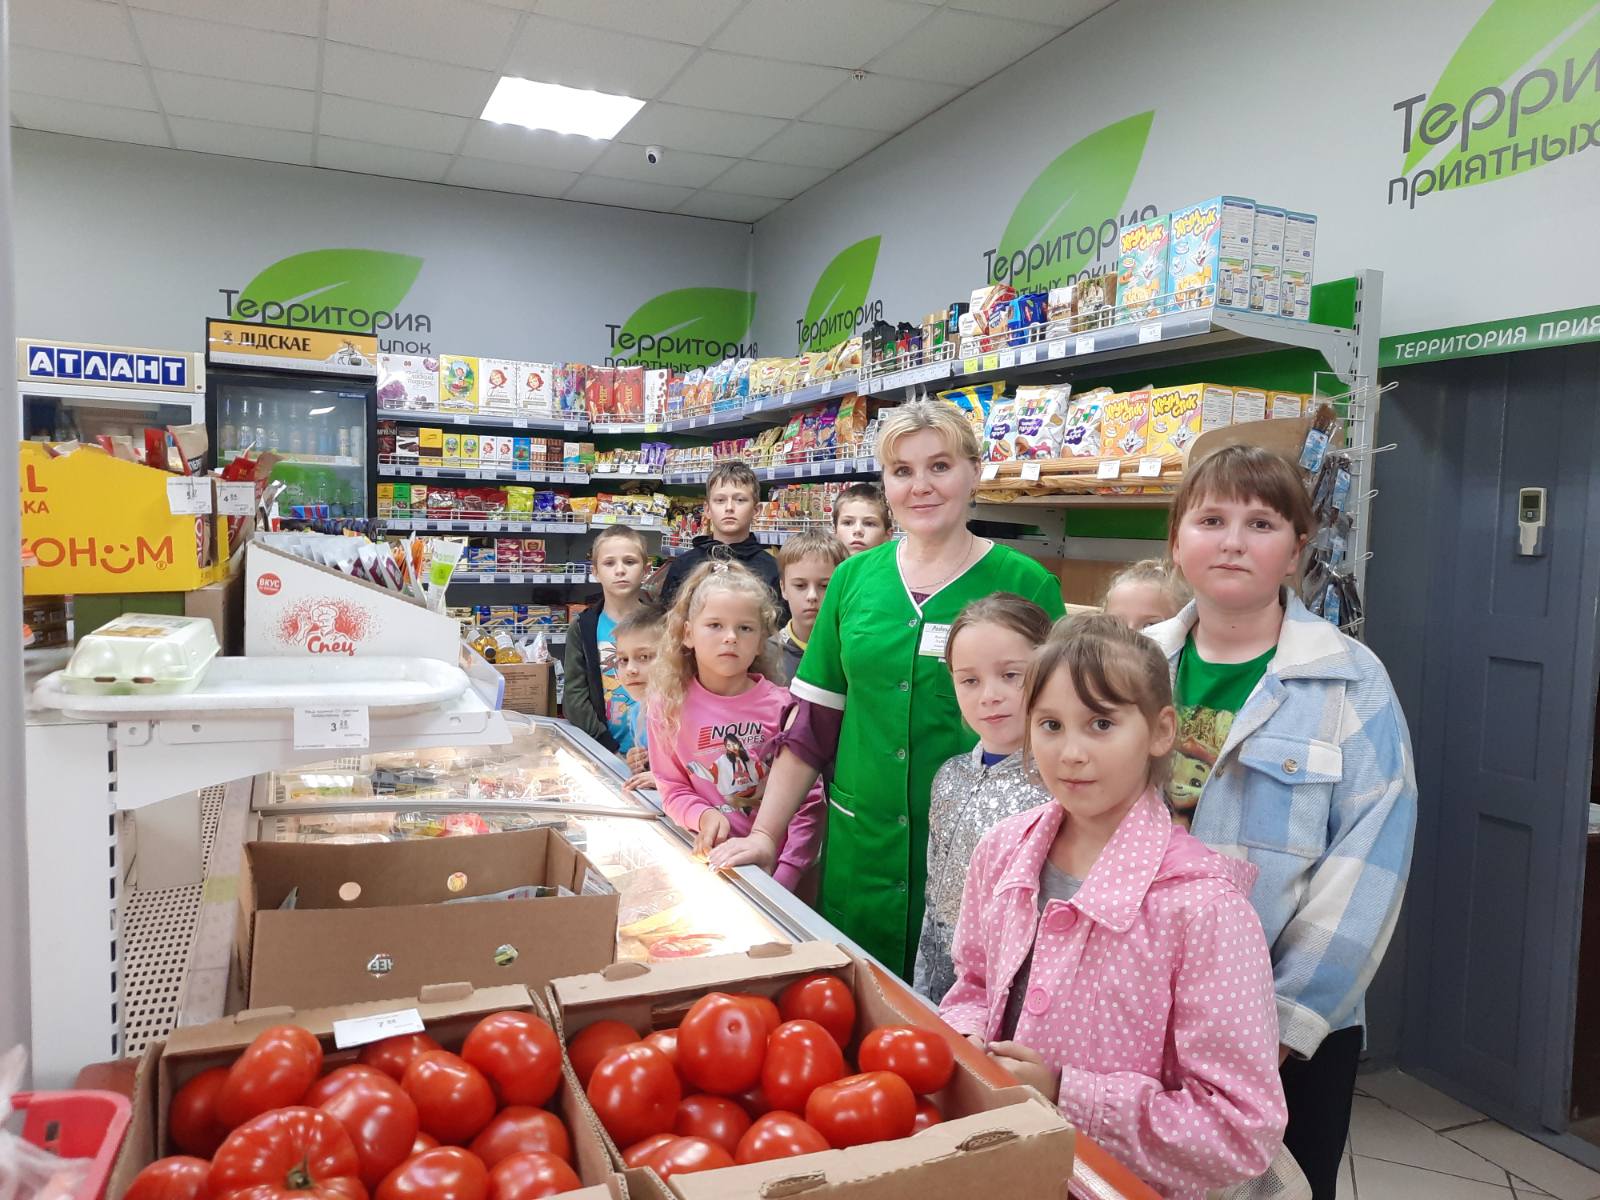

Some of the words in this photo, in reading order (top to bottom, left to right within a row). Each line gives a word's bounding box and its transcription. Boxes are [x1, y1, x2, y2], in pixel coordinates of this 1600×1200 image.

[219, 288, 431, 334] Территория
[796, 299, 883, 349] Территория
[379, 338, 431, 355] упок
[605, 324, 758, 360] Территория
[1395, 326, 1528, 360] ТЕРРИТОРИЯ
[30, 351, 184, 382] АТЛАНТ
[20, 500, 50, 515] КА
[259, 578, 280, 588] ВКУС
[307, 635, 358, 656] Спец
[330, 722, 337, 732] 3
[712, 722, 762, 739] NOUN
